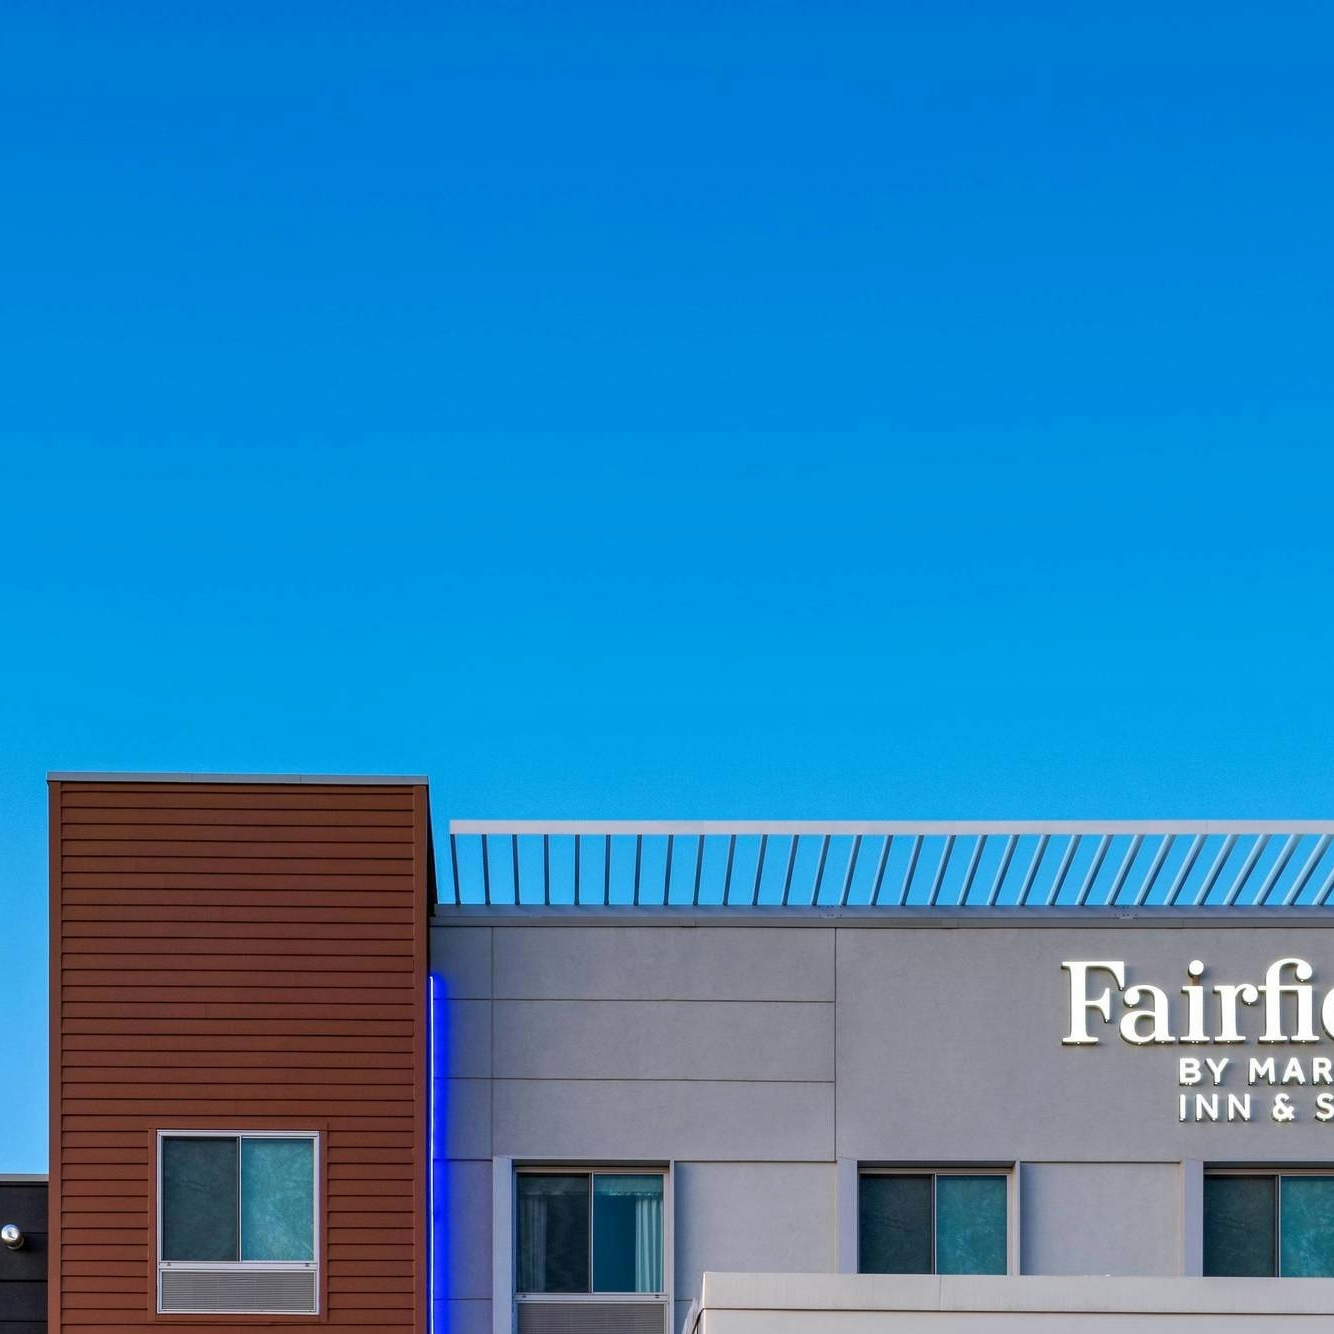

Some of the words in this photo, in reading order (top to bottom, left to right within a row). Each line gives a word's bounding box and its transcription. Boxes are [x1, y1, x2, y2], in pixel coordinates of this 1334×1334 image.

[1179, 1057, 1229, 1085] BY
[1179, 1093, 1251, 1121] INN
[1272, 1093, 1295, 1121] &
